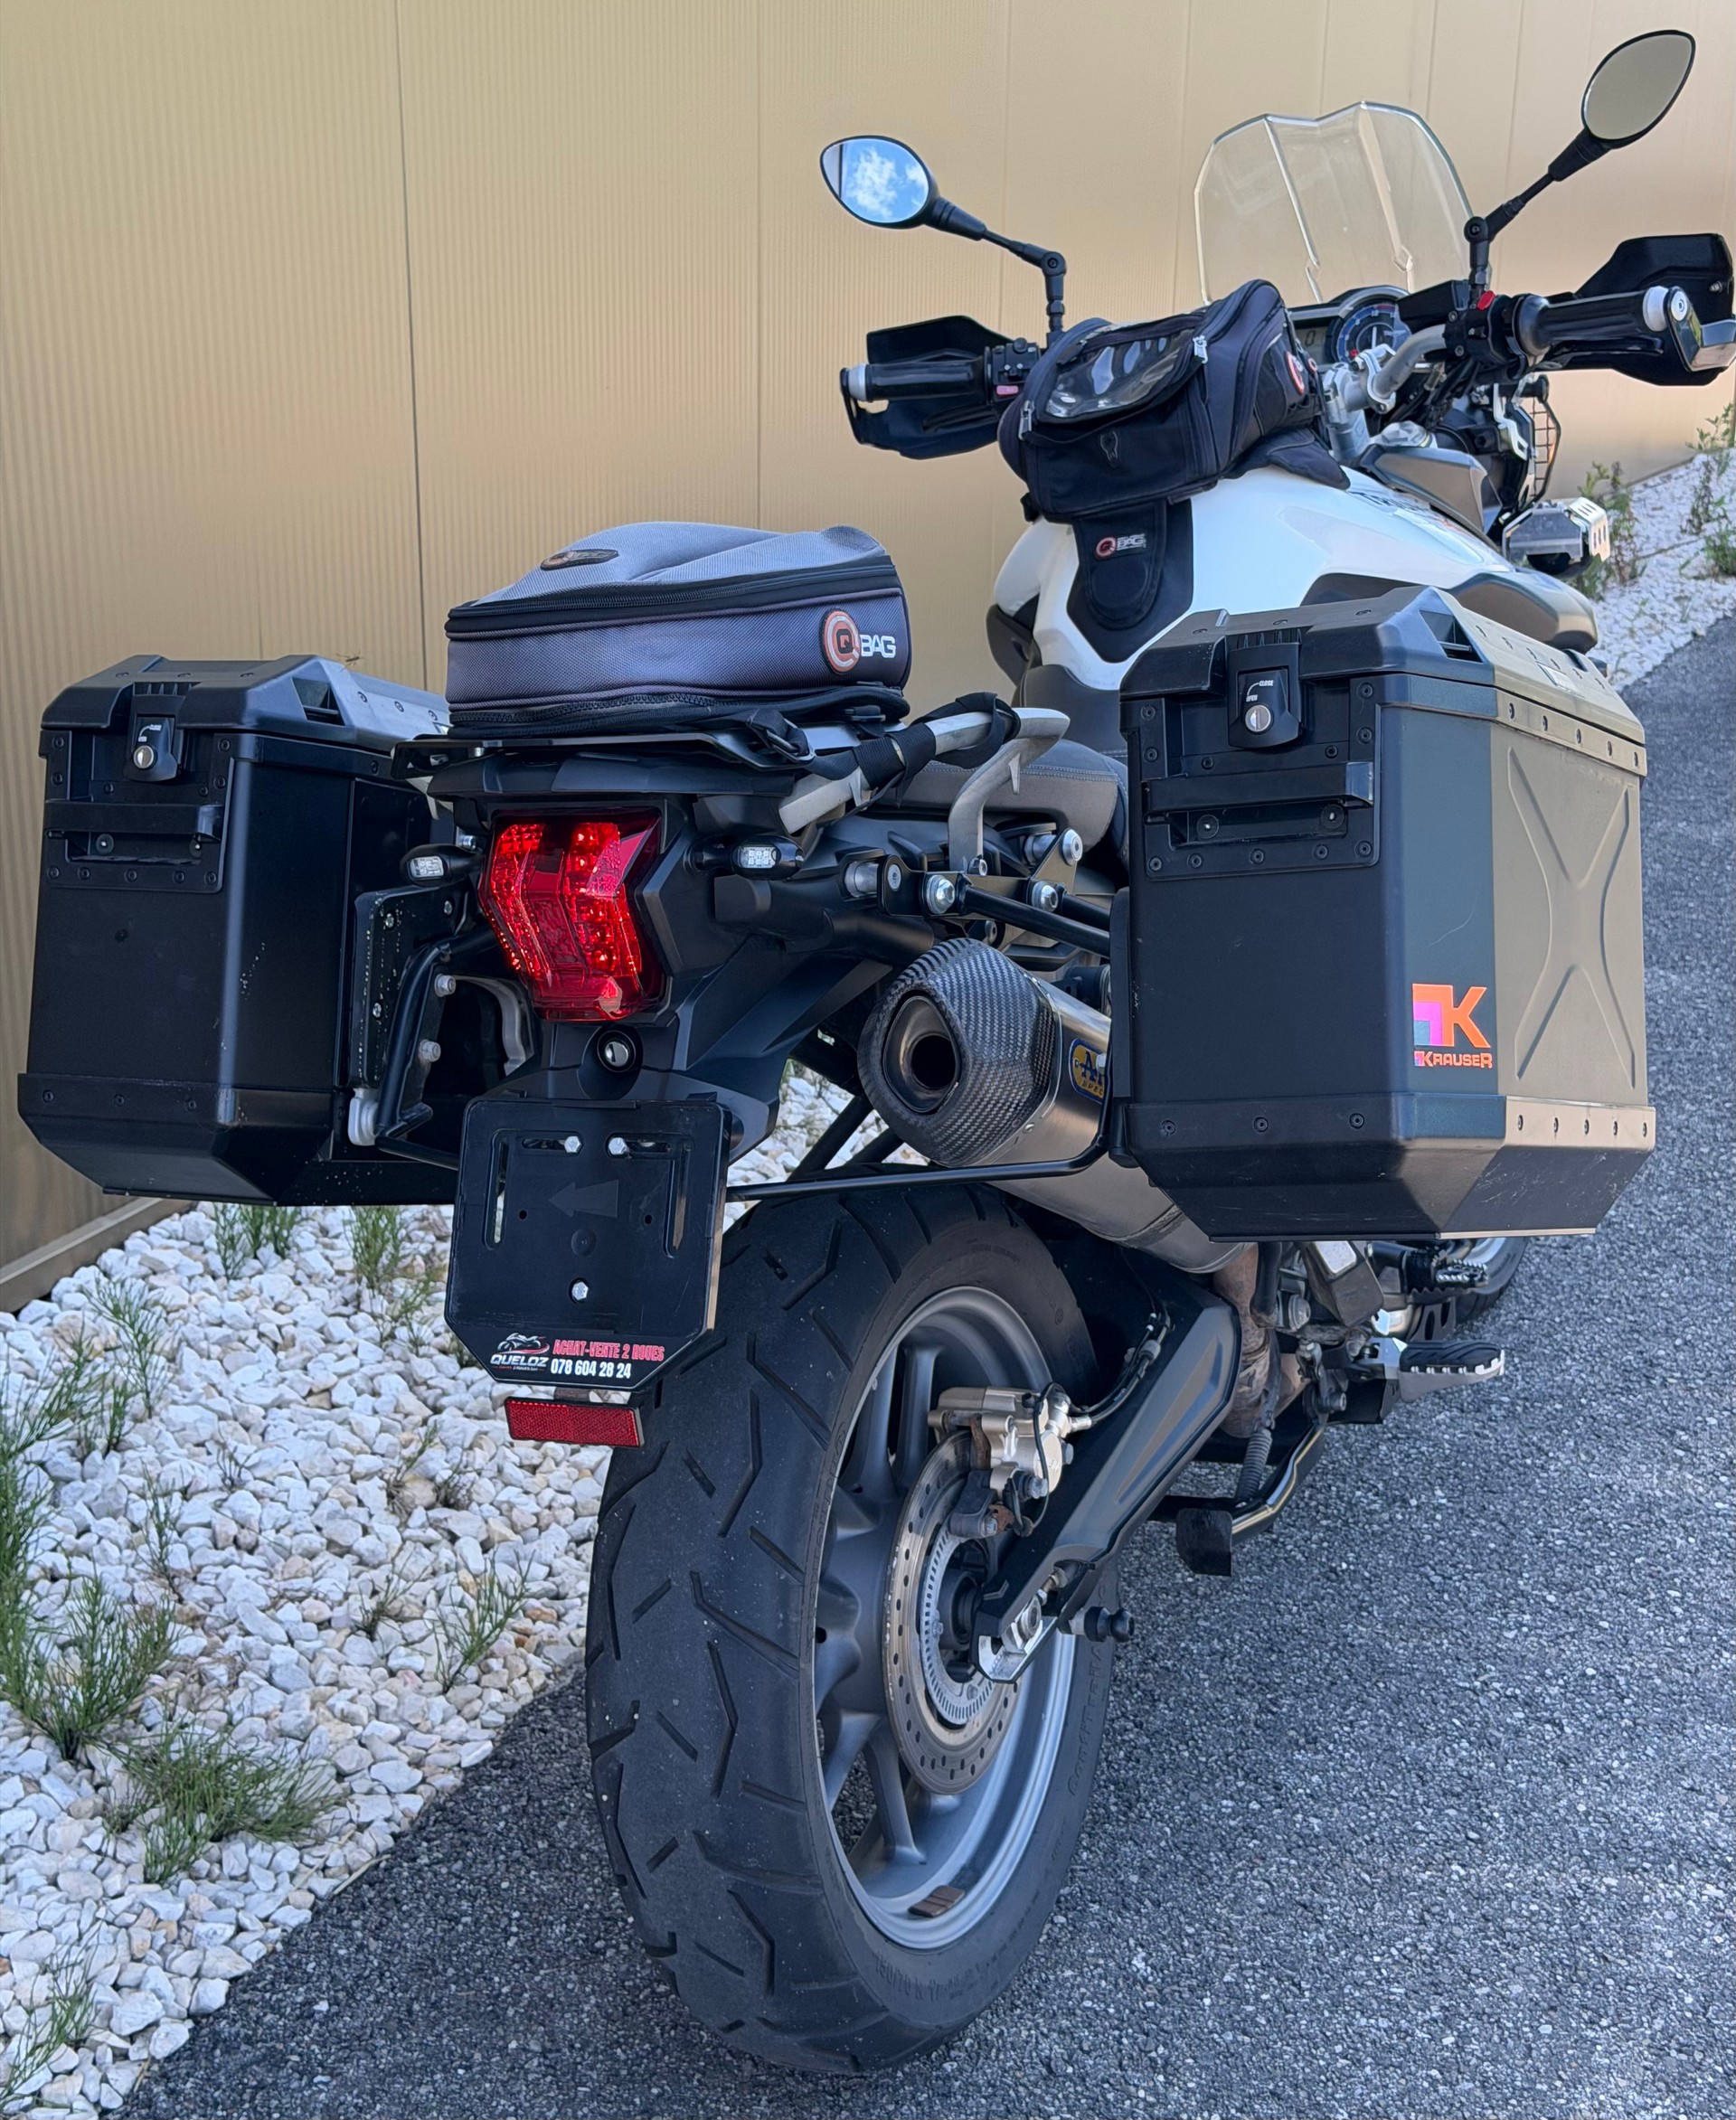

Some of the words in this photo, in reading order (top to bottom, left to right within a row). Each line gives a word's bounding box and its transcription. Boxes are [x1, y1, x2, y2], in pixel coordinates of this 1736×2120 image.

[1414, 1051, 1493, 1069] KRAUSER
[490, 1353, 550, 1368] QUELOZ
[621, 1343, 630, 1360] 2
[631, 1343, 665, 1362] ROUES
[550, 1358, 573, 1375] 078
[574, 1360, 598, 1377] 604
[598, 1362, 615, 1378] 28
[616, 1362, 632, 1380] 24
